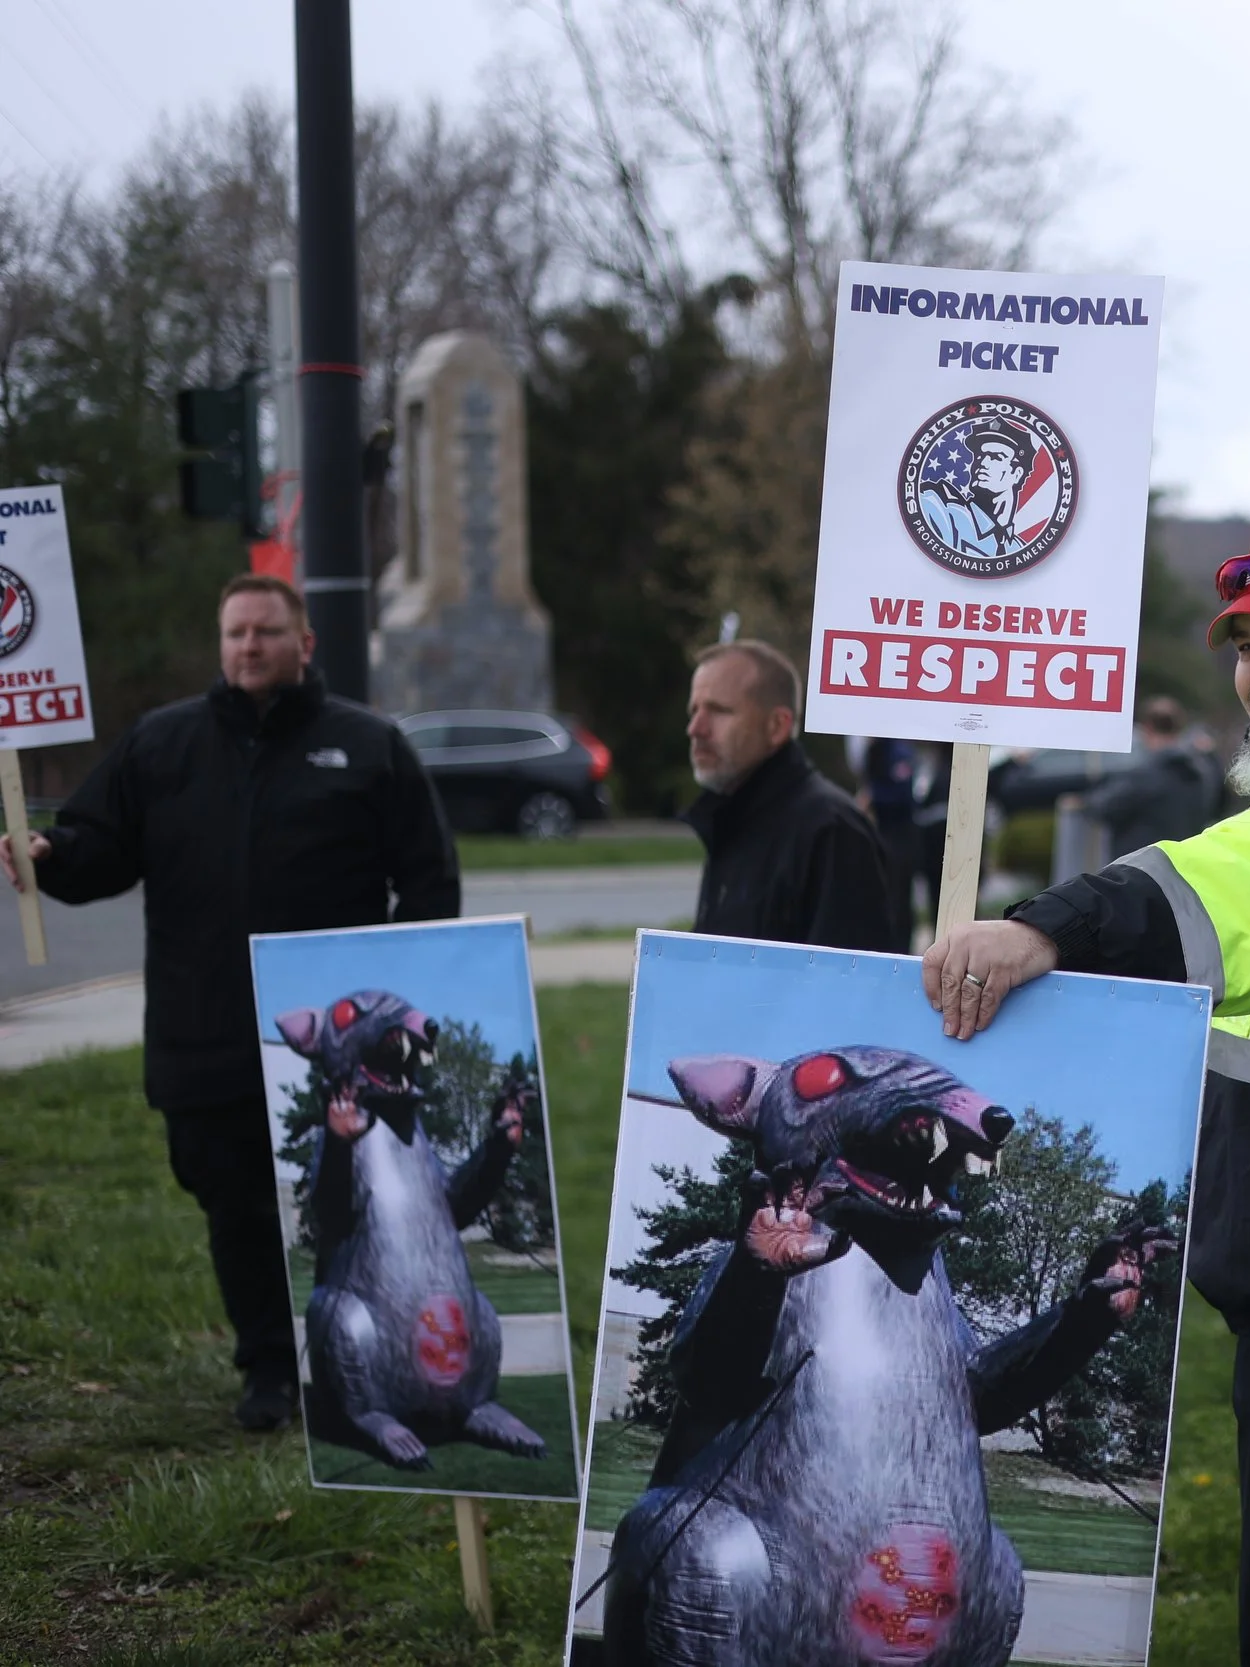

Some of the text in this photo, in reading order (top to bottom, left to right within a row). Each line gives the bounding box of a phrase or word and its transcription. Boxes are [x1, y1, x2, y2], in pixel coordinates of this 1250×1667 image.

[850, 284, 1149, 326] INFORMATIONAL
[938, 340, 1060, 374] PICKET
[904, 402, 1073, 524] SECURITY POLICE FIRE
[912, 518, 1060, 572] PROFESSIONALS OF AMERICA
[869, 596, 1088, 637] WE DESERVE
[827, 637, 1120, 703] RESPECT
